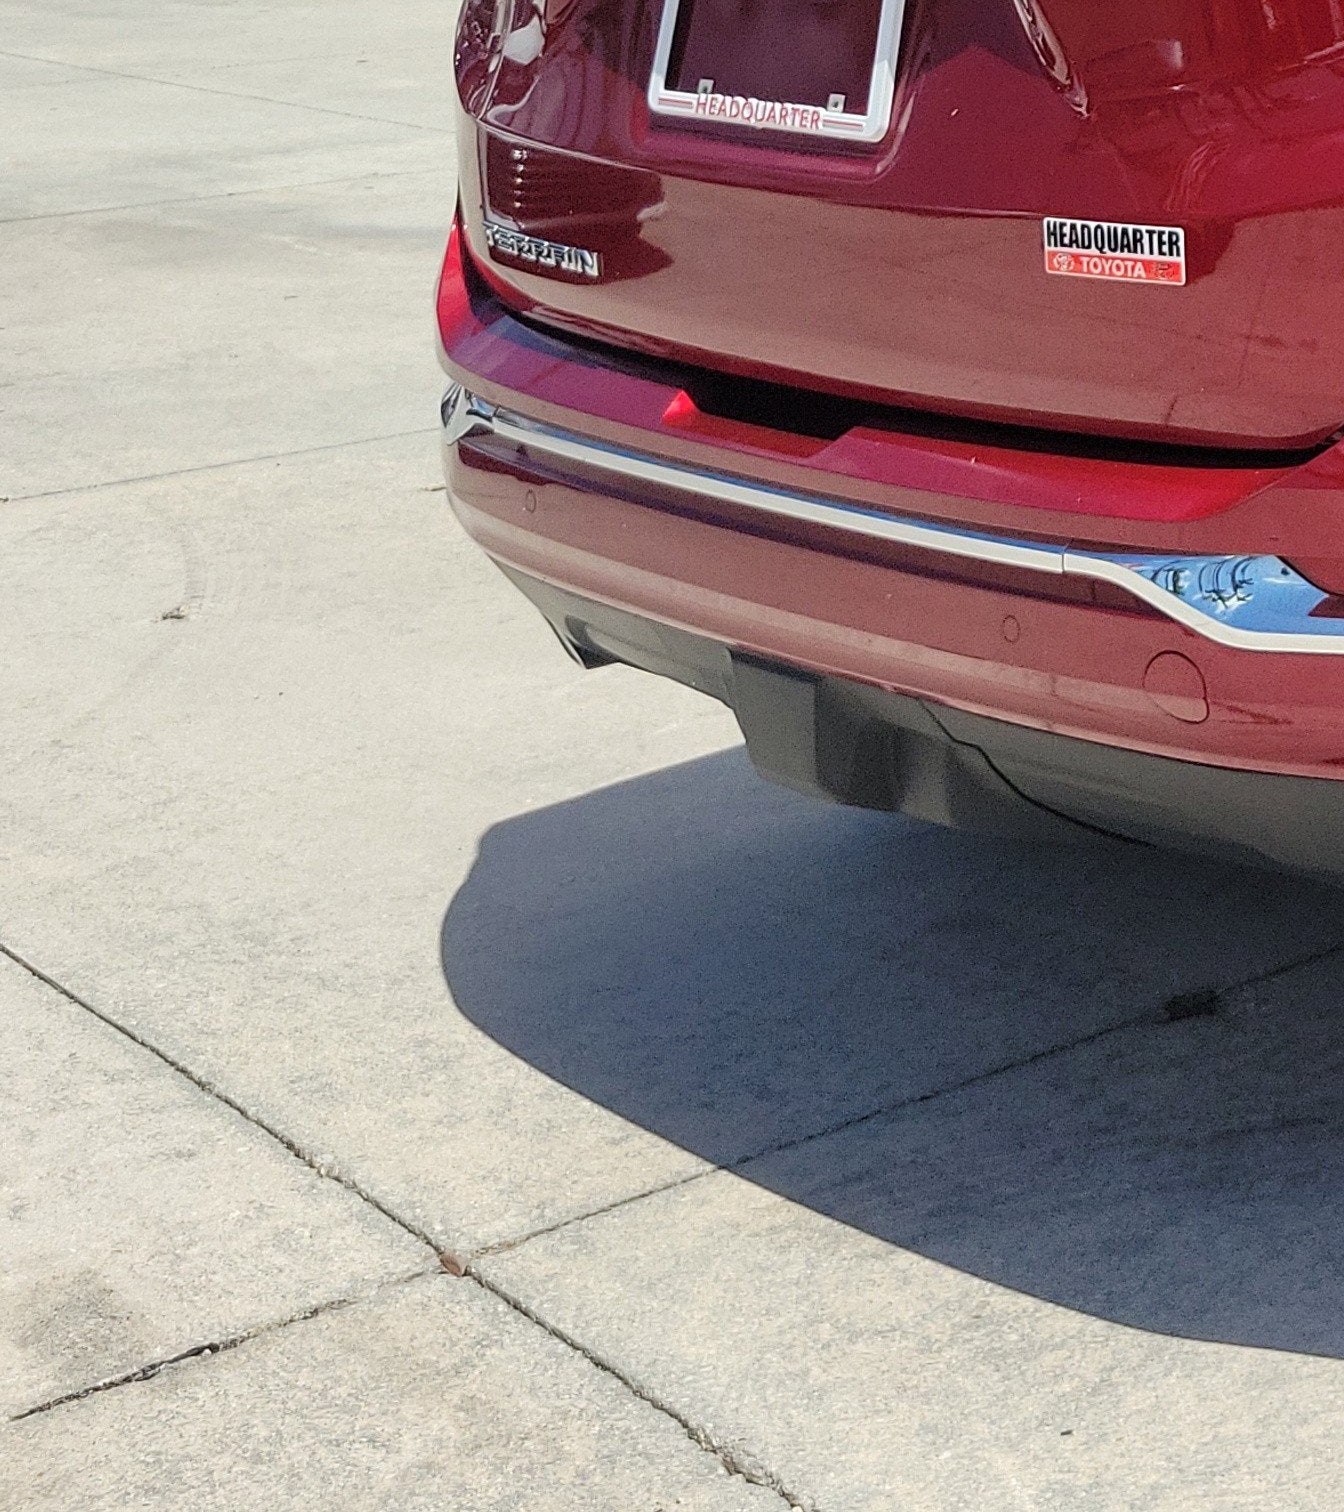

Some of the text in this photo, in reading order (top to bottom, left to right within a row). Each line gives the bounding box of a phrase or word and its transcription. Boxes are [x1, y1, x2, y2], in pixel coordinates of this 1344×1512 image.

[696, 94, 821, 129] HEADQUARTER
[1046, 220, 1181, 257] HEADQUARTER
[1079, 256, 1147, 278] TOYOTA
